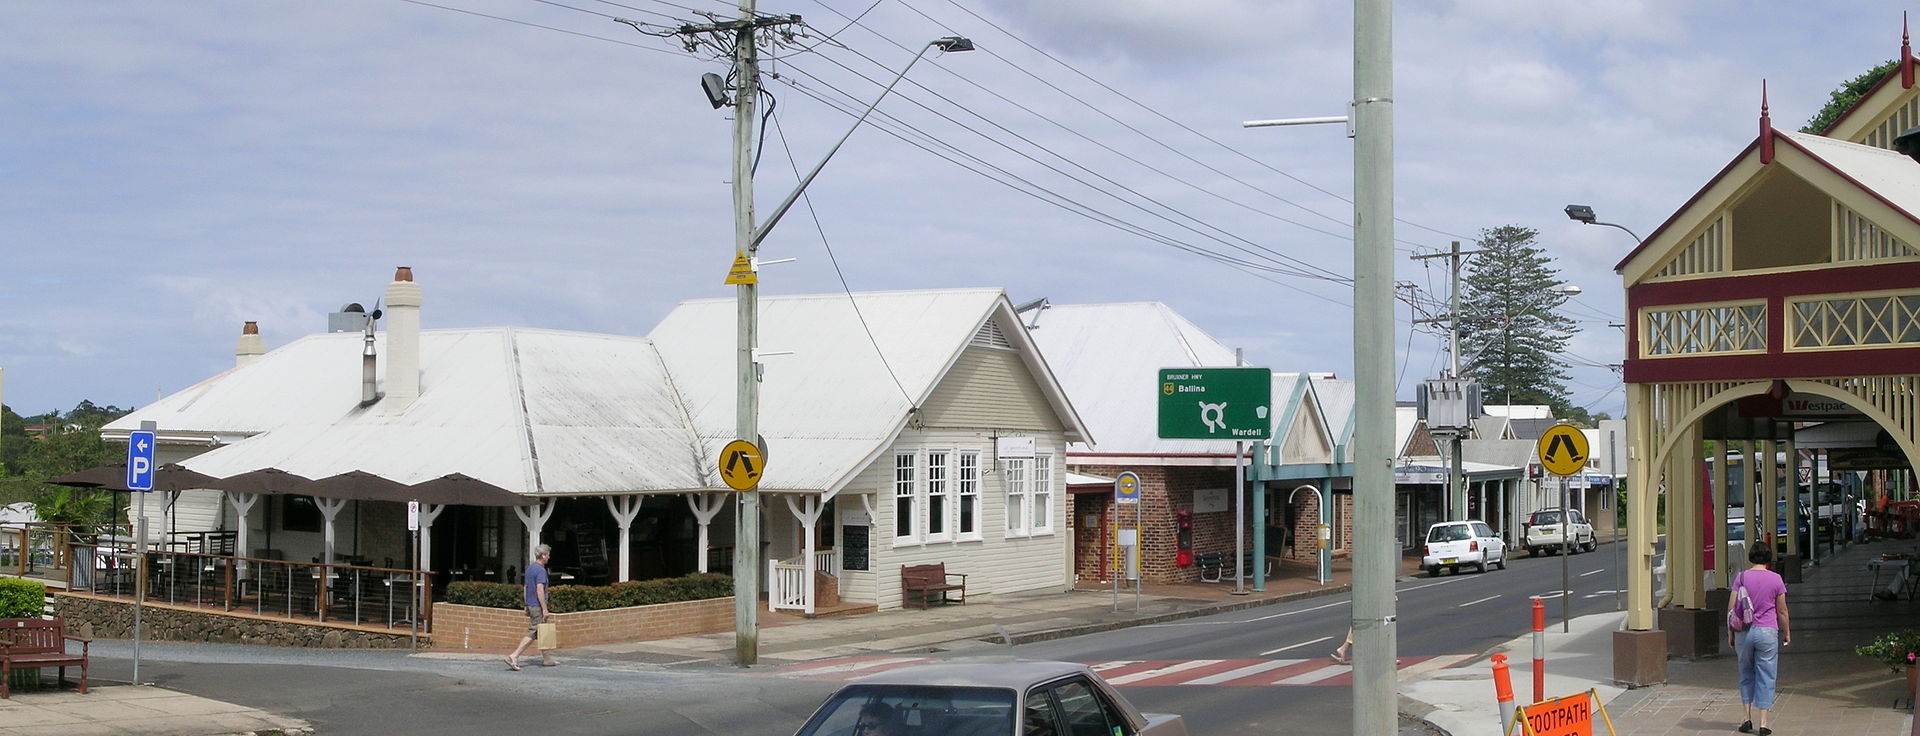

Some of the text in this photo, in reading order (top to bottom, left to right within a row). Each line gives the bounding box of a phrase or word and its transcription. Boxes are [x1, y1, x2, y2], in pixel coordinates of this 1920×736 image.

[1178, 384, 1206, 393] Ballina
[1788, 400, 1846, 412] Westpac
[1231, 428, 1262, 436] Wardell
[132, 456, 150, 484] P
[1527, 702, 1588, 734] FOOTPATH
